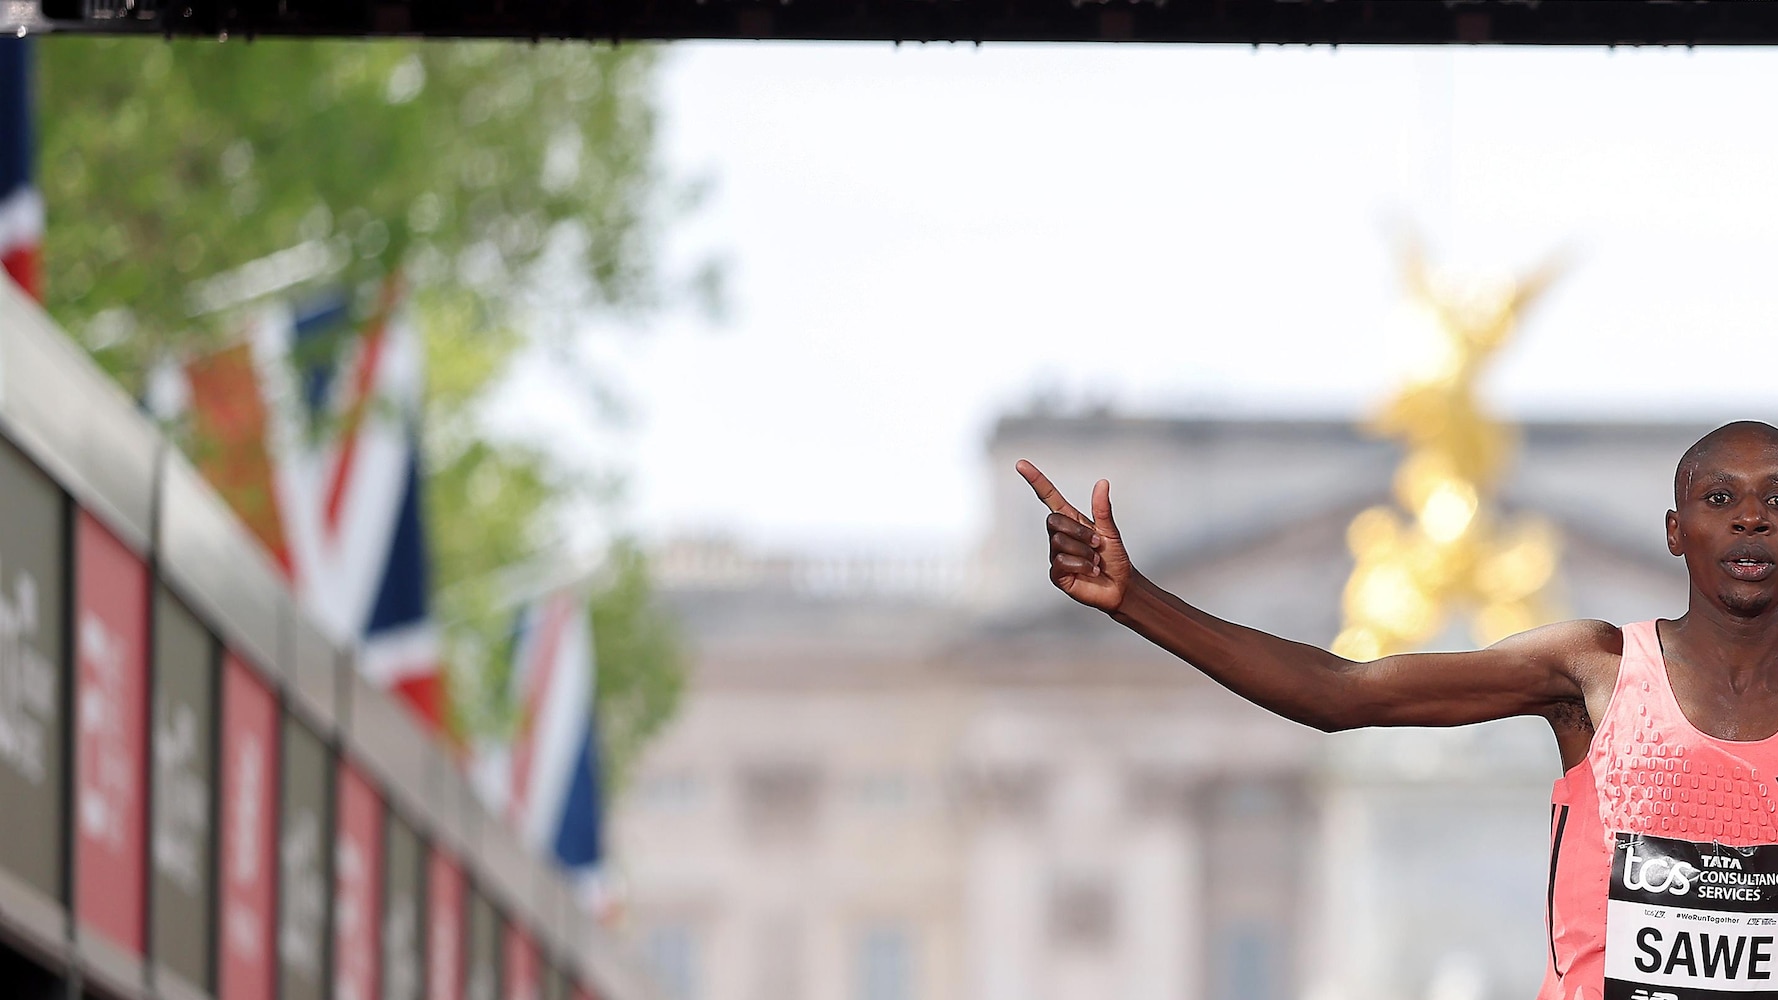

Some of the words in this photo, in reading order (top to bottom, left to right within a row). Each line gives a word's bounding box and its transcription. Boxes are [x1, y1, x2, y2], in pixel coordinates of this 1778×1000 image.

[1700, 854, 1743, 870] TATA
[1623, 845, 1691, 896] tcs
[1697, 886, 1762, 901] SERVICES
[1676, 913, 1740, 924] #WeRunTogether
[1634, 927, 1775, 980] SAWE
